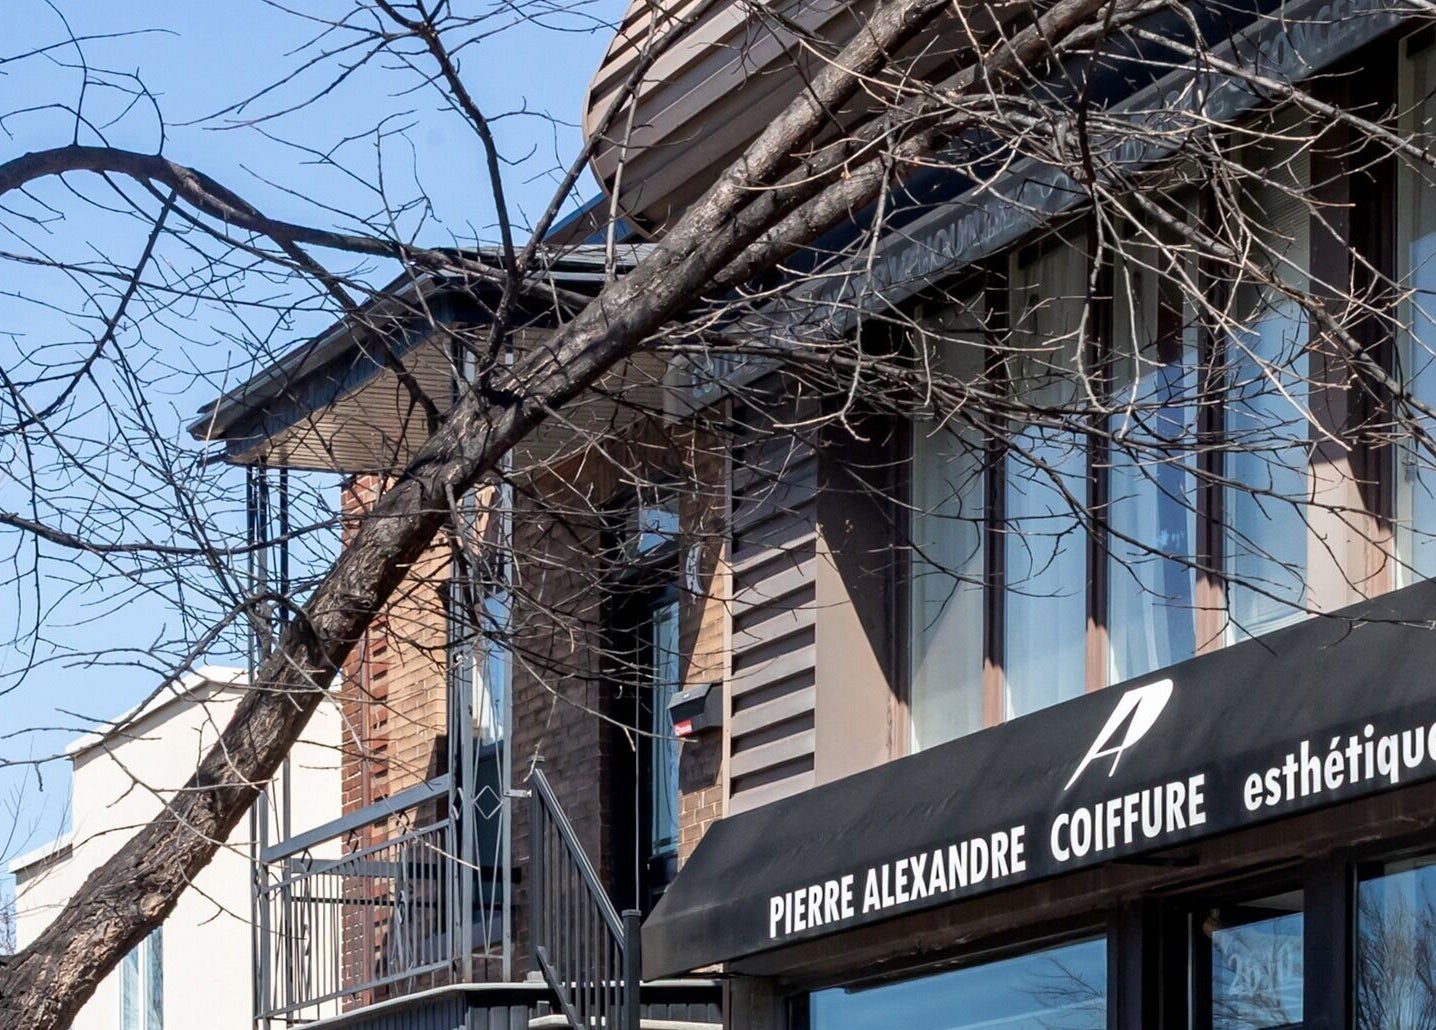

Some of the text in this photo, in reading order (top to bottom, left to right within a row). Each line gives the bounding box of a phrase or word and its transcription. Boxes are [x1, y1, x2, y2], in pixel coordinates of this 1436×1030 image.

[768, 874, 855, 938] PIERRE
[862, 825, 1027, 914] ALEXANDRE
[1050, 773, 1207, 863] COIFFURE
